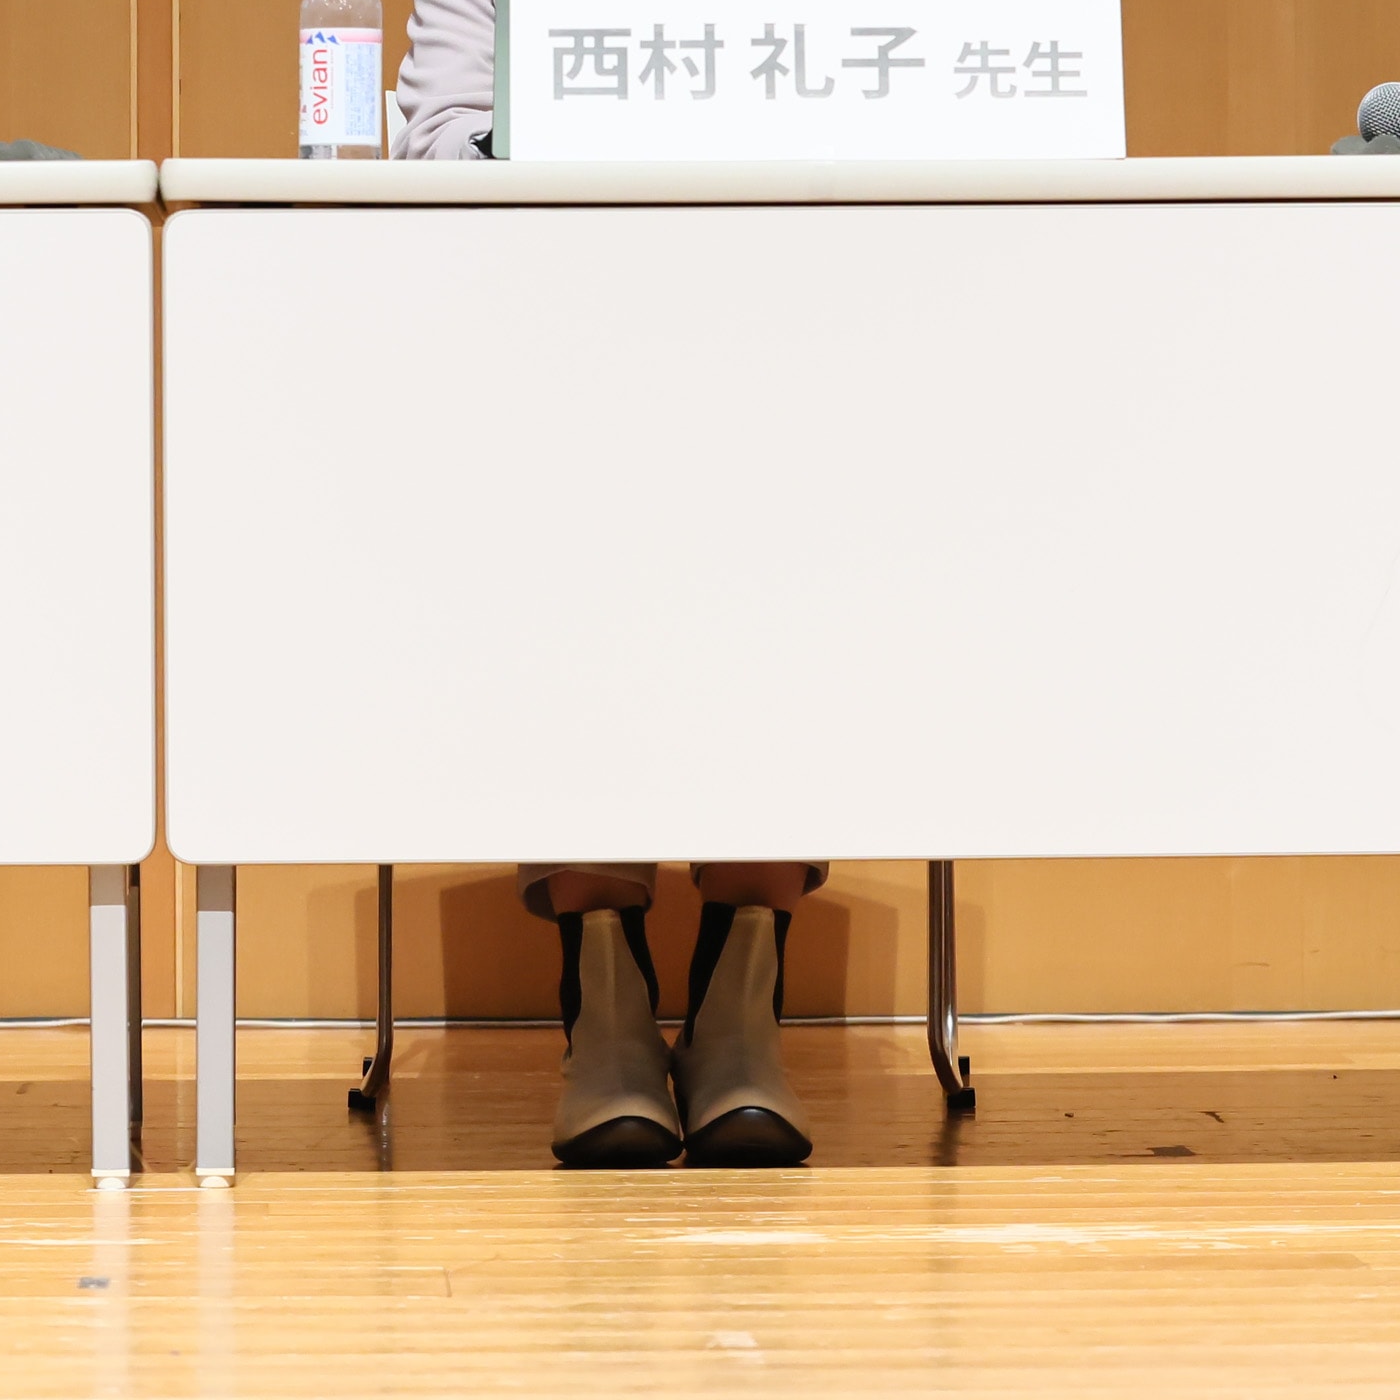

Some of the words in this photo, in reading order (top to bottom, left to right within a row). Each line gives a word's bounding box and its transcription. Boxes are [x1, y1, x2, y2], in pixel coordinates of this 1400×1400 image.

[310, 48, 328, 125] evian
[547, 23, 724, 101] 西村
[750, 23, 925, 99] 礼子
[953, 40, 1088, 100] 先生
